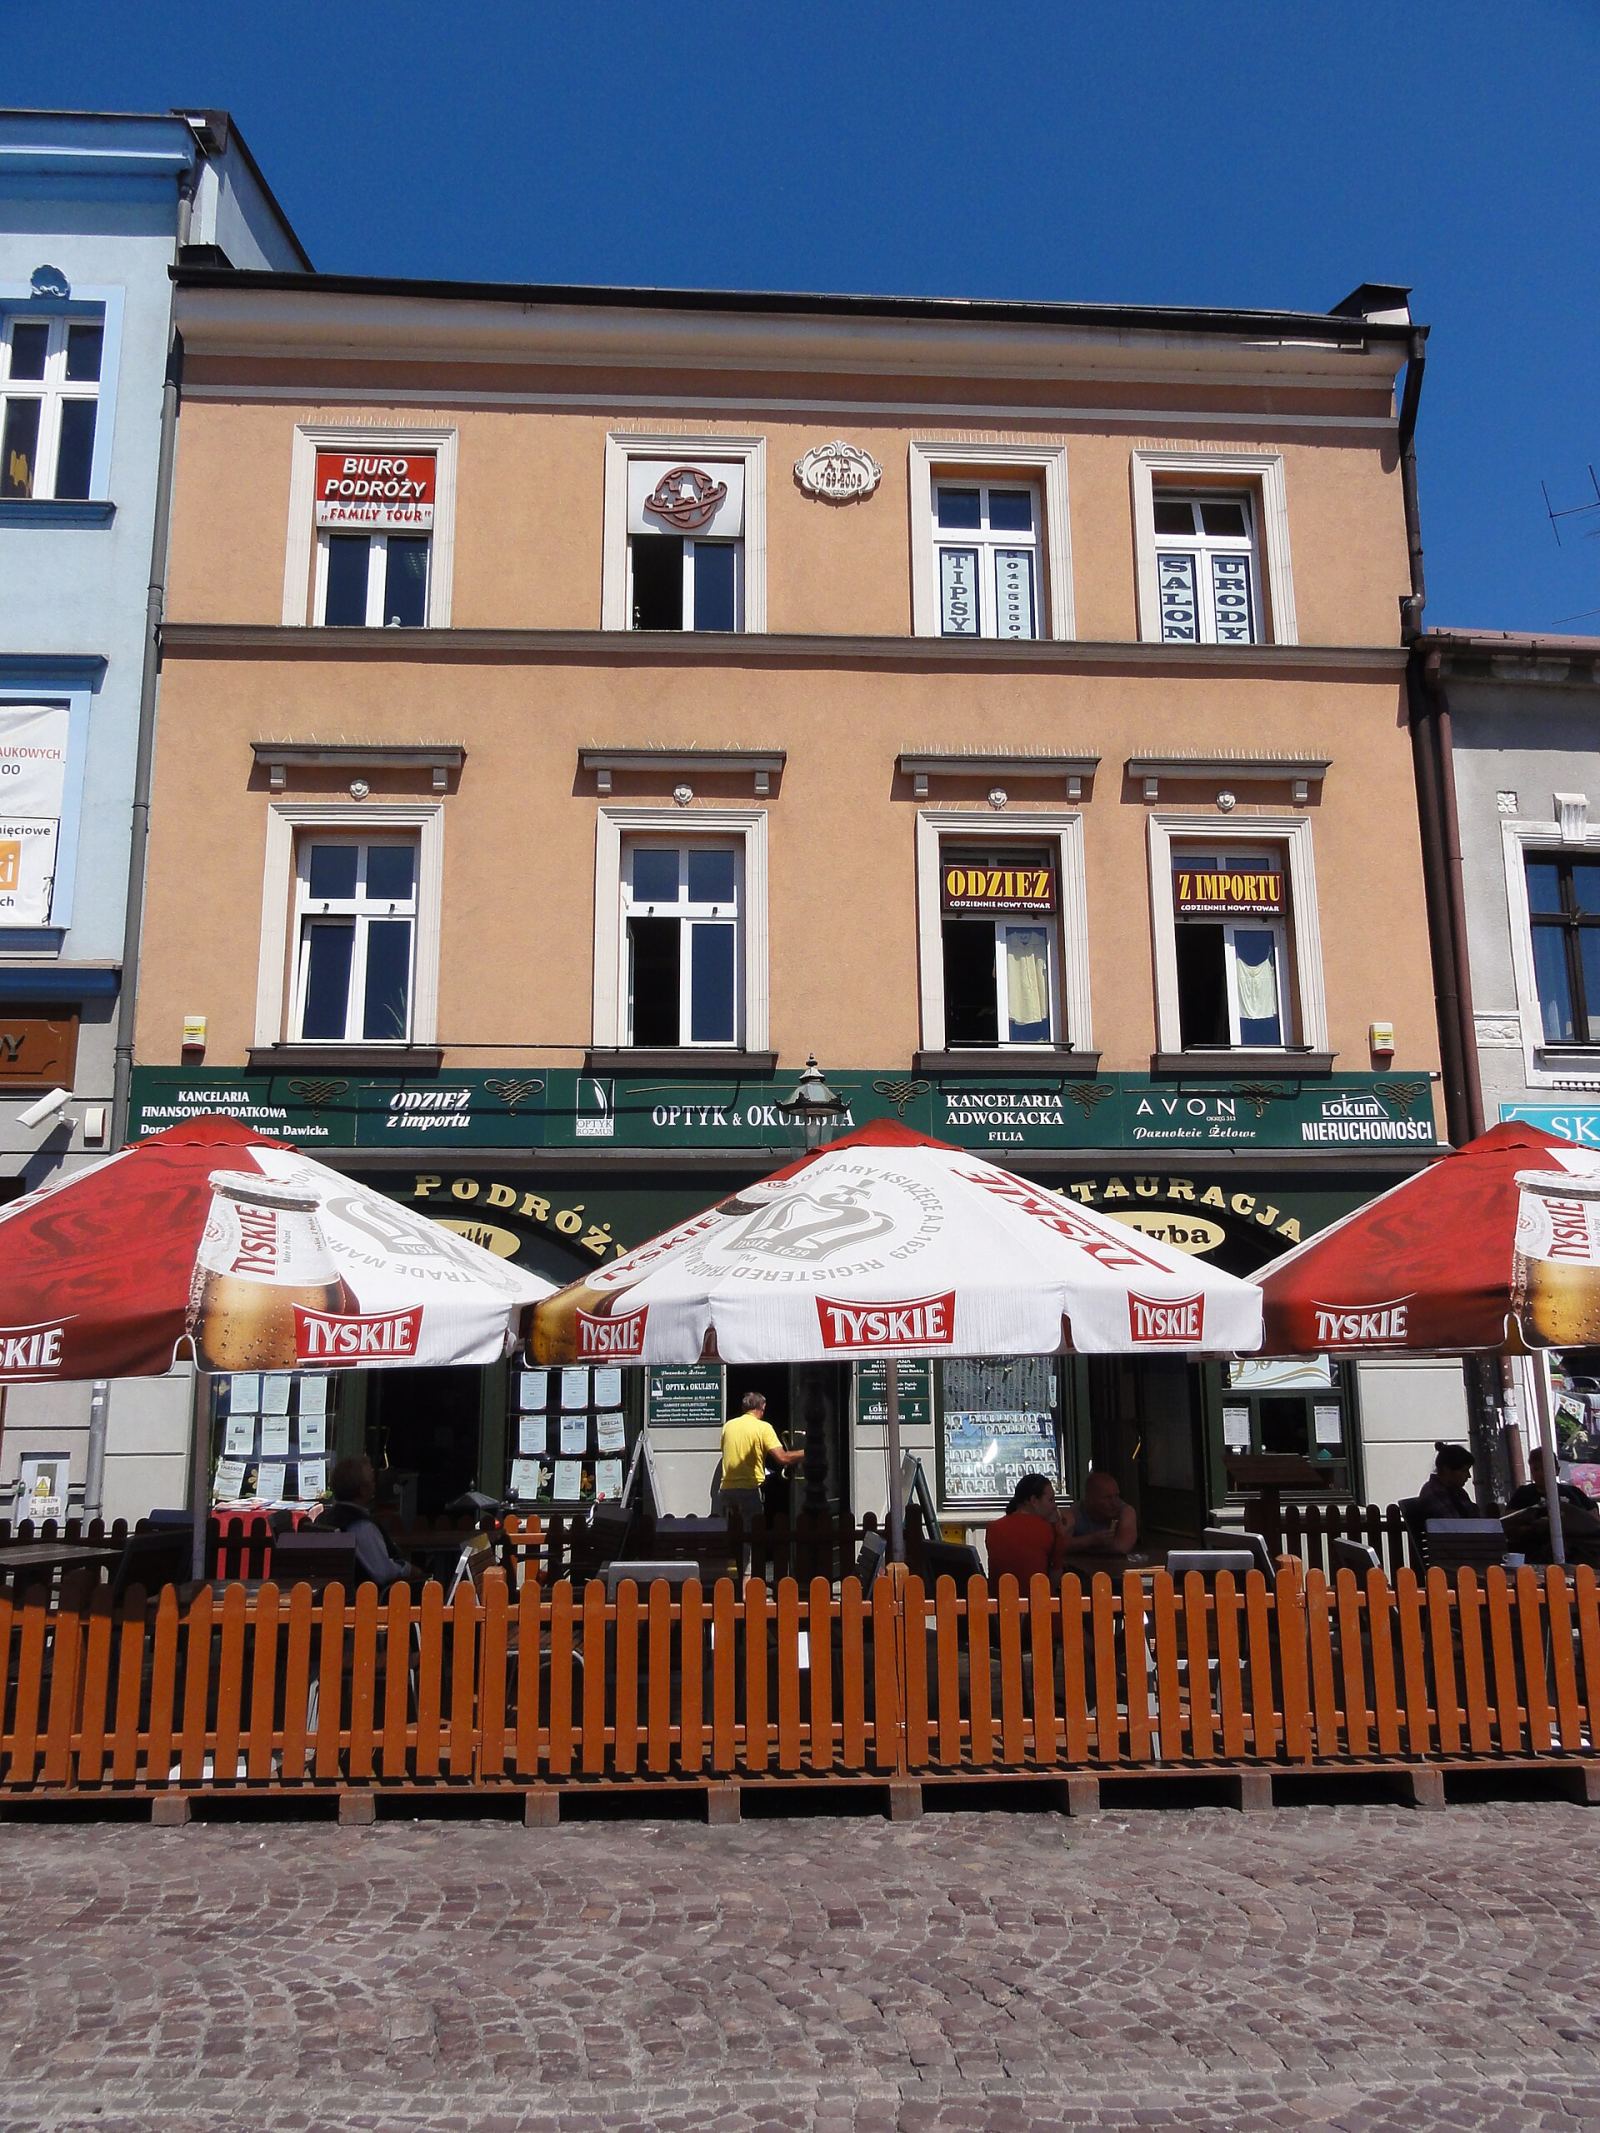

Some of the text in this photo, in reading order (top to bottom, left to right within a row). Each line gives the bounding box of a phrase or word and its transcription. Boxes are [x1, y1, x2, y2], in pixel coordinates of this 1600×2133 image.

[343, 457, 409, 475] BIURO
[325, 477, 427, 498] PODRÓŻY
[947, 553, 971, 632] TIPSY
[1162, 560, 1194, 640] SALON
[1214, 561, 1248, 640] URODY
[947, 869, 1050, 898] ODZIEŻ
[1179, 874, 1280, 901] Z IMPORTU
[949, 900, 996, 908] CODZIENNIE
[997, 901, 1022, 909] NOWY
[178, 1091, 250, 1102] KANCELARIA
[390, 1089, 472, 1111] ODZIEŻ
[945, 1095, 1063, 1108] KANCELARIA
[1136, 1098, 1236, 1116] AVON
[142, 1106, 288, 1118] FINANSOWO-PODATKOWA
[386, 1112, 471, 1131] z importu
[652, 1105, 856, 1127] OPTYK & OKULA
[945, 1111, 1065, 1125] ADWOKACKA
[252, 1123, 280, 1135] Anna
[282, 1124, 329, 1135] Dawicka
[576, 1119, 613, 1128] OPTYK
[576, 1128, 613, 1136] ROZMUS
[1133, 1124, 1257, 1140] Paznokcie Żelowe
[1301, 1117, 1433, 1140] NIERUCHOMOŚCI
[988, 1131, 1025, 1141] FILIA
[229, 1204, 277, 1276] TYSKIE
[1546, 1199, 1591, 1259] TYSKIE
[594, 1214, 722, 1283] TYSKIE
[733, 1258, 885, 1282] REGISTERED
[826, 1301, 949, 1343] TYSKIE
[1133, 1301, 1201, 1338] TYSKIE
[1314, 1305, 1409, 1341] TYSKIE
[303, 1316, 414, 1354] TYSKIE
[579, 1316, 641, 1351] TYSKIE
[665, 1383, 686, 1391] OPTYK
[689, 1382, 720, 1391] OKULISTA
